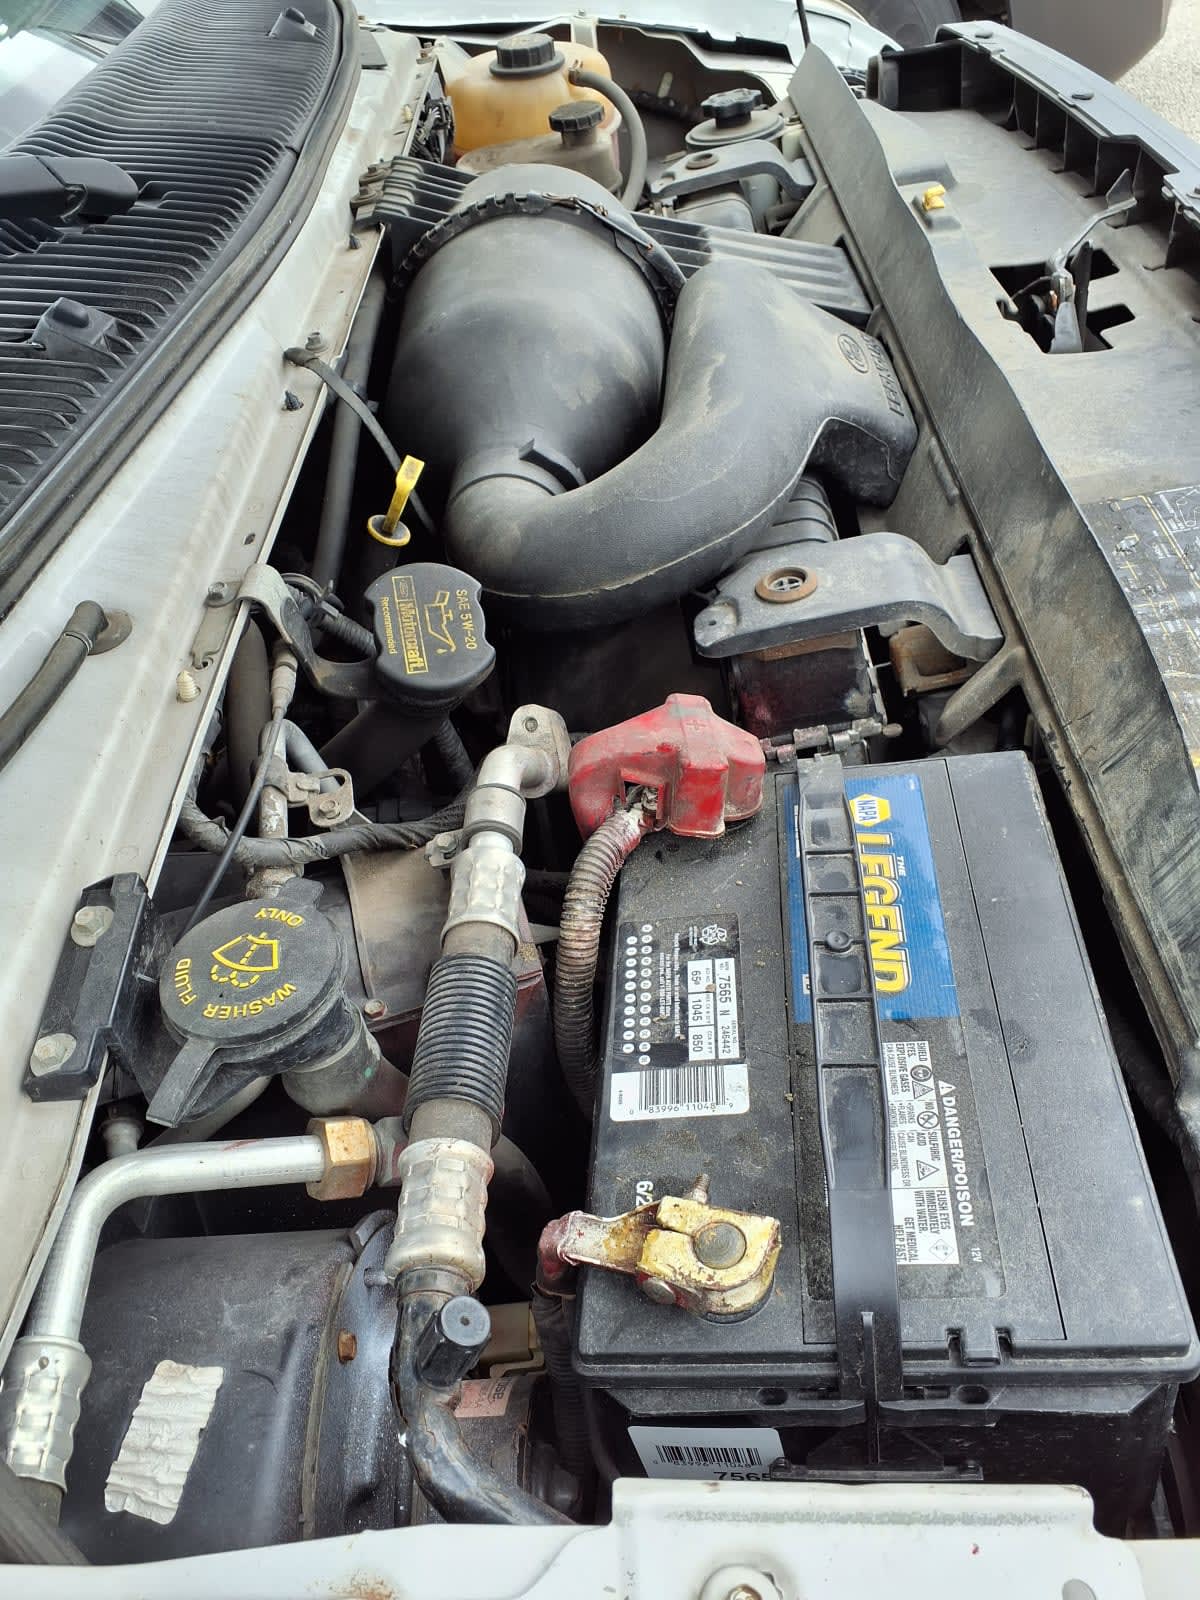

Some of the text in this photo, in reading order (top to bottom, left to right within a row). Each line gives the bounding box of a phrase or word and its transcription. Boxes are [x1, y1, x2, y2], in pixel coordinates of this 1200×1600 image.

[455, 588, 478, 650] SAE 5W-20
[856, 799, 876, 822] NAPA
[896, 855, 907, 877] THE
[855, 832, 912, 994] LEGEND
[174, 907, 305, 1019] WASHER FLUID ONLY
[718, 974, 732, 1004] 7565
[691, 998, 703, 1022] 1045
[719, 1009, 729, 1017] N
[692, 1034, 704, 1053] 850
[720, 1023, 731, 1054] 246442
[888, 1054, 897, 1068] CAUSE
[917, 1042, 929, 1062] SHIELD
[896, 1043, 911, 1093] EXPLOSIVE GASES
[889, 1069, 900, 1096] BLINDNESS
[648, 1103, 680, 1113] 83996
[685, 1102, 717, 1111] 11048
[925, 1101, 935, 1110] NO
[916, 1131, 927, 1147] ACID
[928, 1131, 941, 1161] SULFURIC
[898, 1150, 911, 1178] BLINDNESS
[942, 1096, 975, 1227] DANGER/POISON
[903, 1179, 912, 1187] OR
[914, 1190, 925, 1207] WITH
[936, 1190, 951, 1230] FLUSH EYES
[925, 1190, 941, 1235] IMMEDIATELY
[894, 1225, 904, 1241] HELP
[904, 1217, 919, 1263] GET MEDICAL
[970, 1247, 983, 1262] 12V
